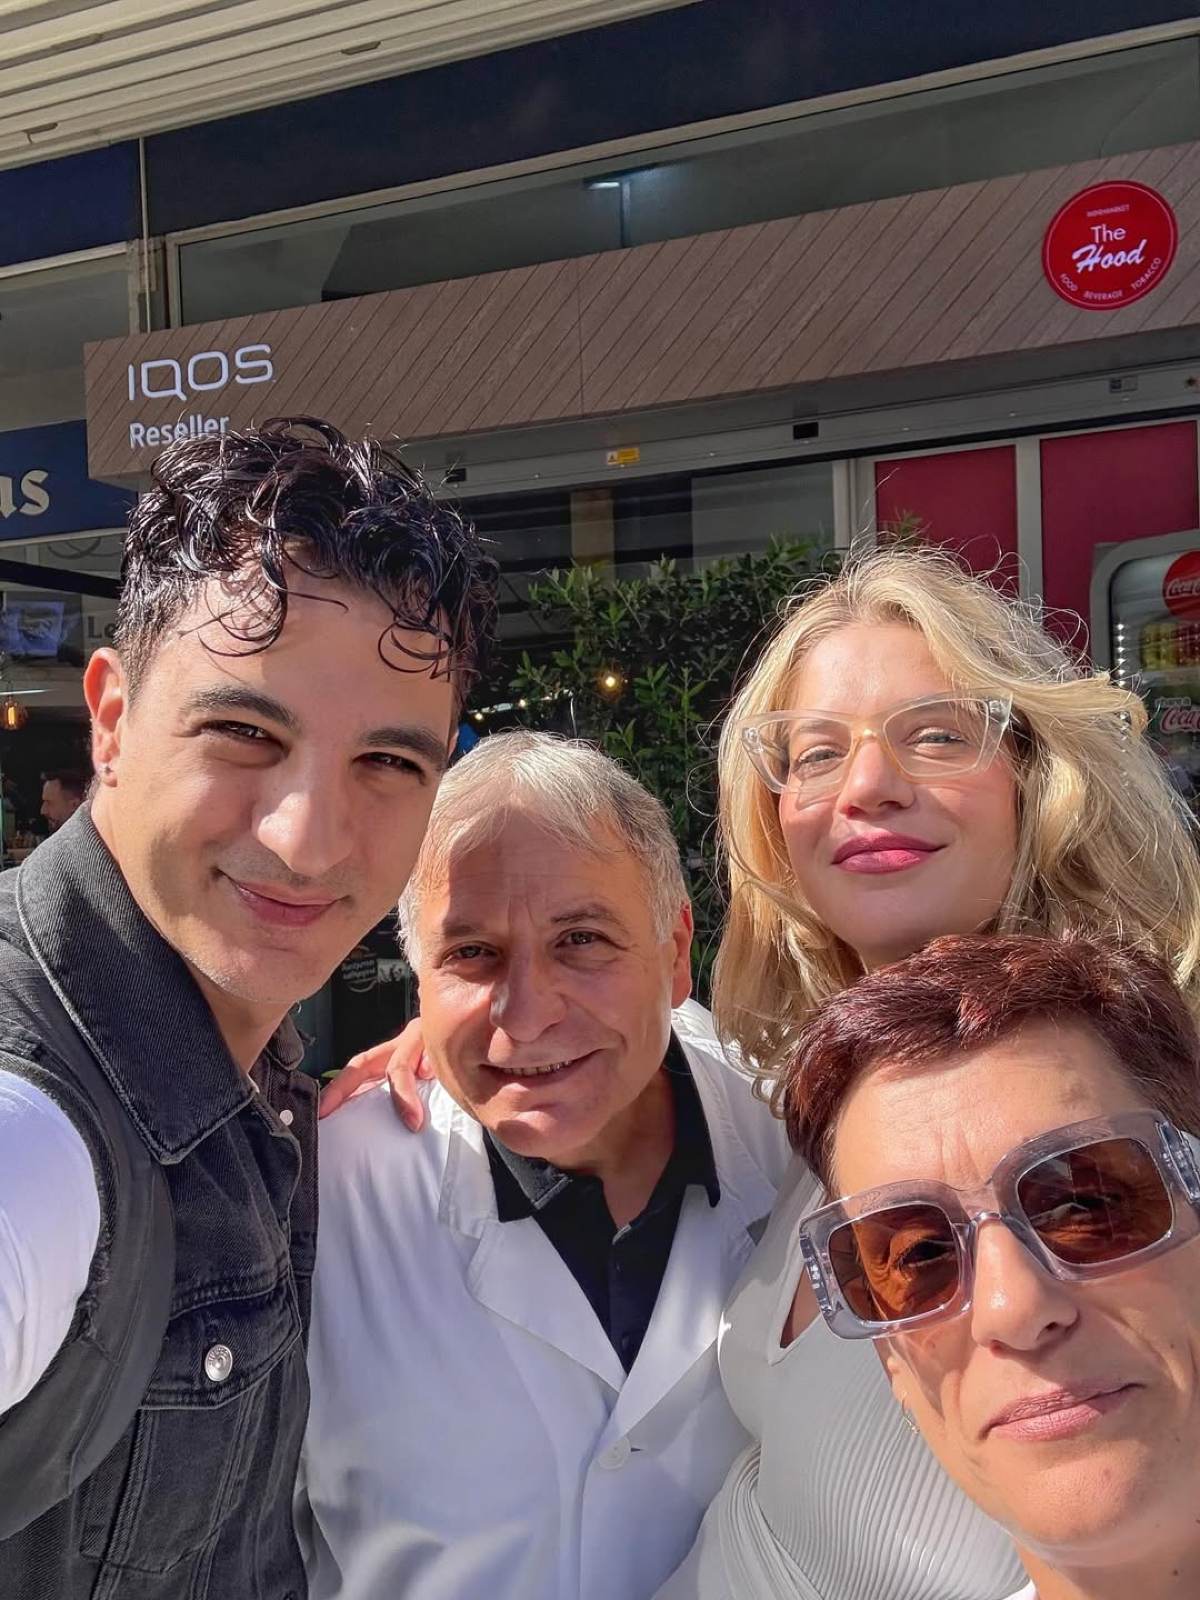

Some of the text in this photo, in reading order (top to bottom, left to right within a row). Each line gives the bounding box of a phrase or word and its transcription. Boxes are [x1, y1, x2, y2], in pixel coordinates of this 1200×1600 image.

[1090, 223, 1126, 244] The
[1072, 239, 1147, 273] Hood
[1060, 257, 1162, 301] FOOD BEVERAGE TOBACCO
[128, 344, 274, 402] IQOS
[129, 413, 230, 449] Reseller
